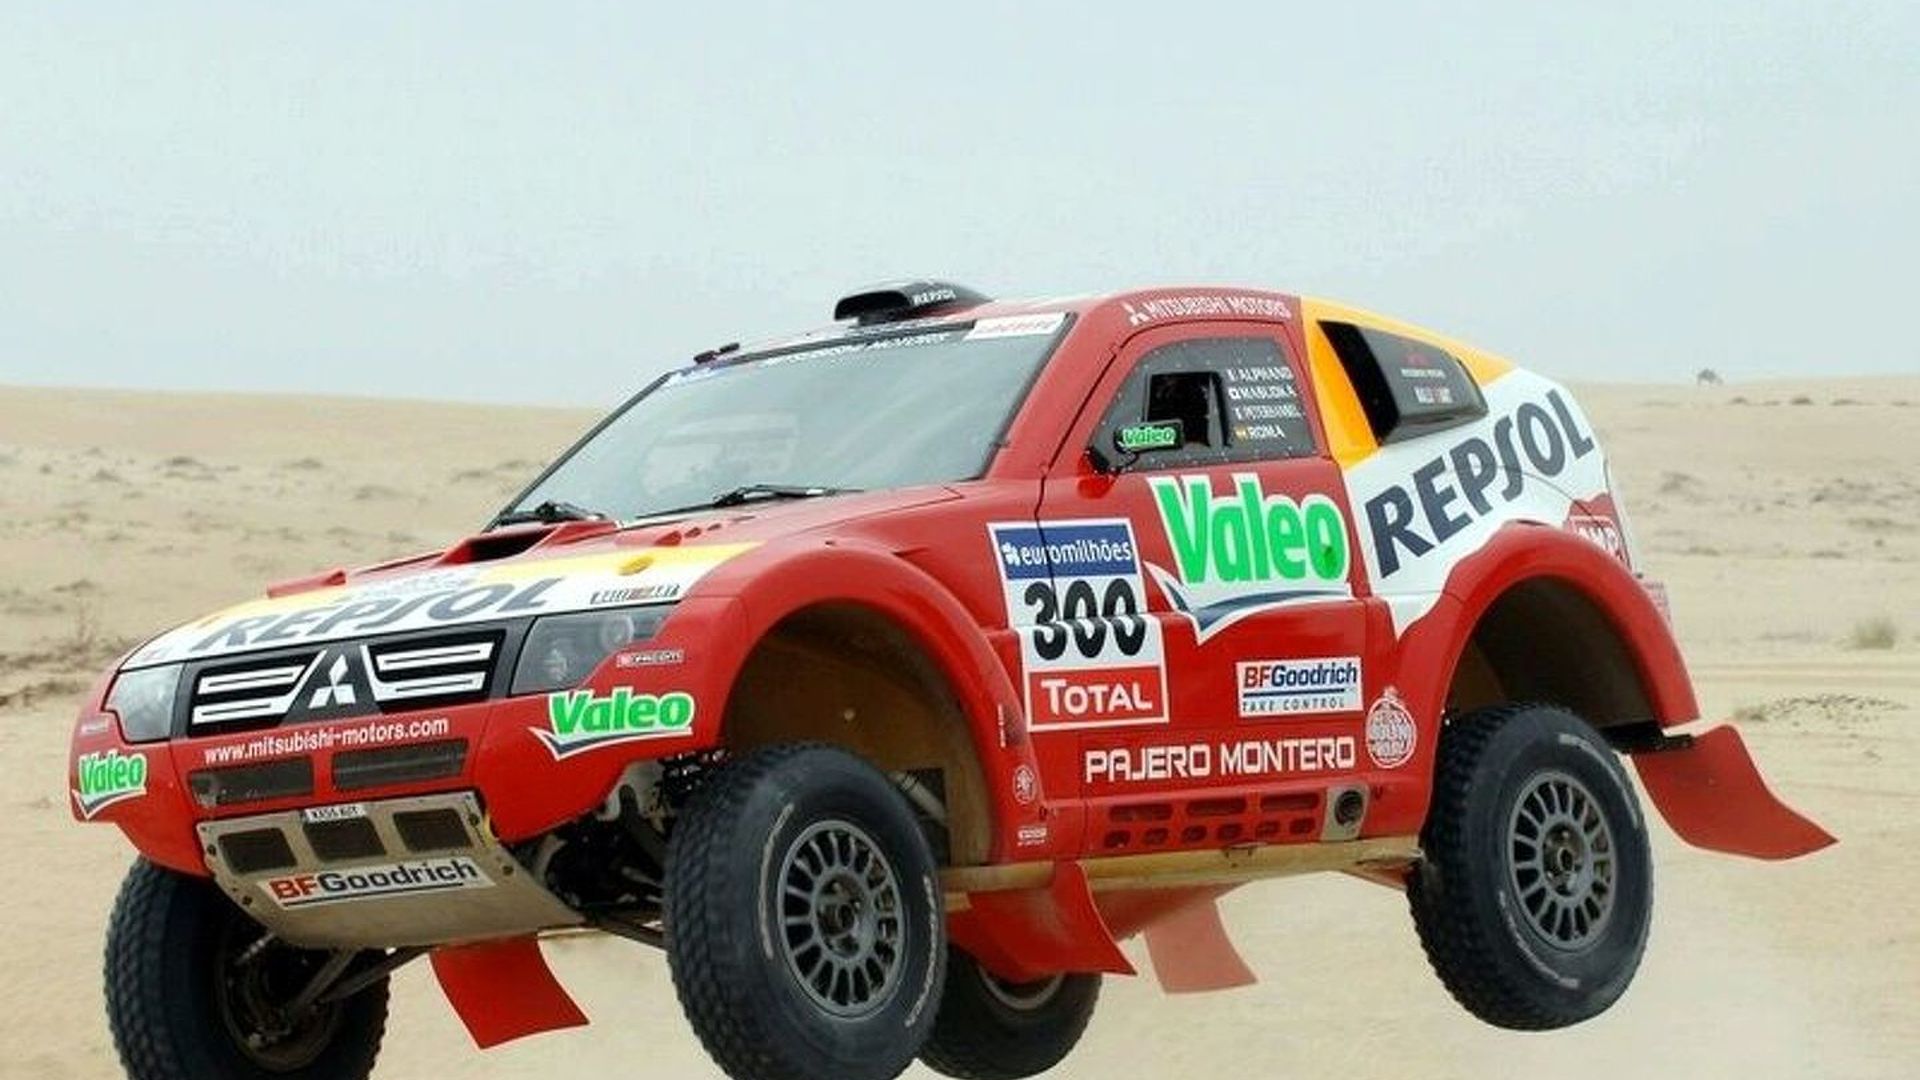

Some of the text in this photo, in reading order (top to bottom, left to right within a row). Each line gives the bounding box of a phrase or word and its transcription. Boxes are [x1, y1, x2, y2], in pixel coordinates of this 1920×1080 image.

[1142, 297, 1292, 318] MITSUBISHI MOTORS
[1121, 427, 1176, 447] Valeo
[1247, 425, 1286, 439] ROMA
[1364, 388, 1595, 579] REPSOL
[1022, 539, 1132, 566] euromilhões
[1152, 479, 1348, 585] Valeo
[188, 576, 562, 654] REPSOL
[1024, 577, 1146, 661] 300
[1244, 662, 1358, 689] BFGoodrich
[550, 687, 694, 735] Valeo
[1041, 678, 1153, 716] TOTAL
[1243, 697, 1345, 712] TAKE CONTROL
[203, 717, 448, 765] www.mitsubishi-motors.com
[1085, 743, 1211, 784] PAJERO
[1220, 735, 1356, 776] MONTERO
[79, 751, 147, 796] Valeo
[268, 860, 478, 900] BFGoodrich
